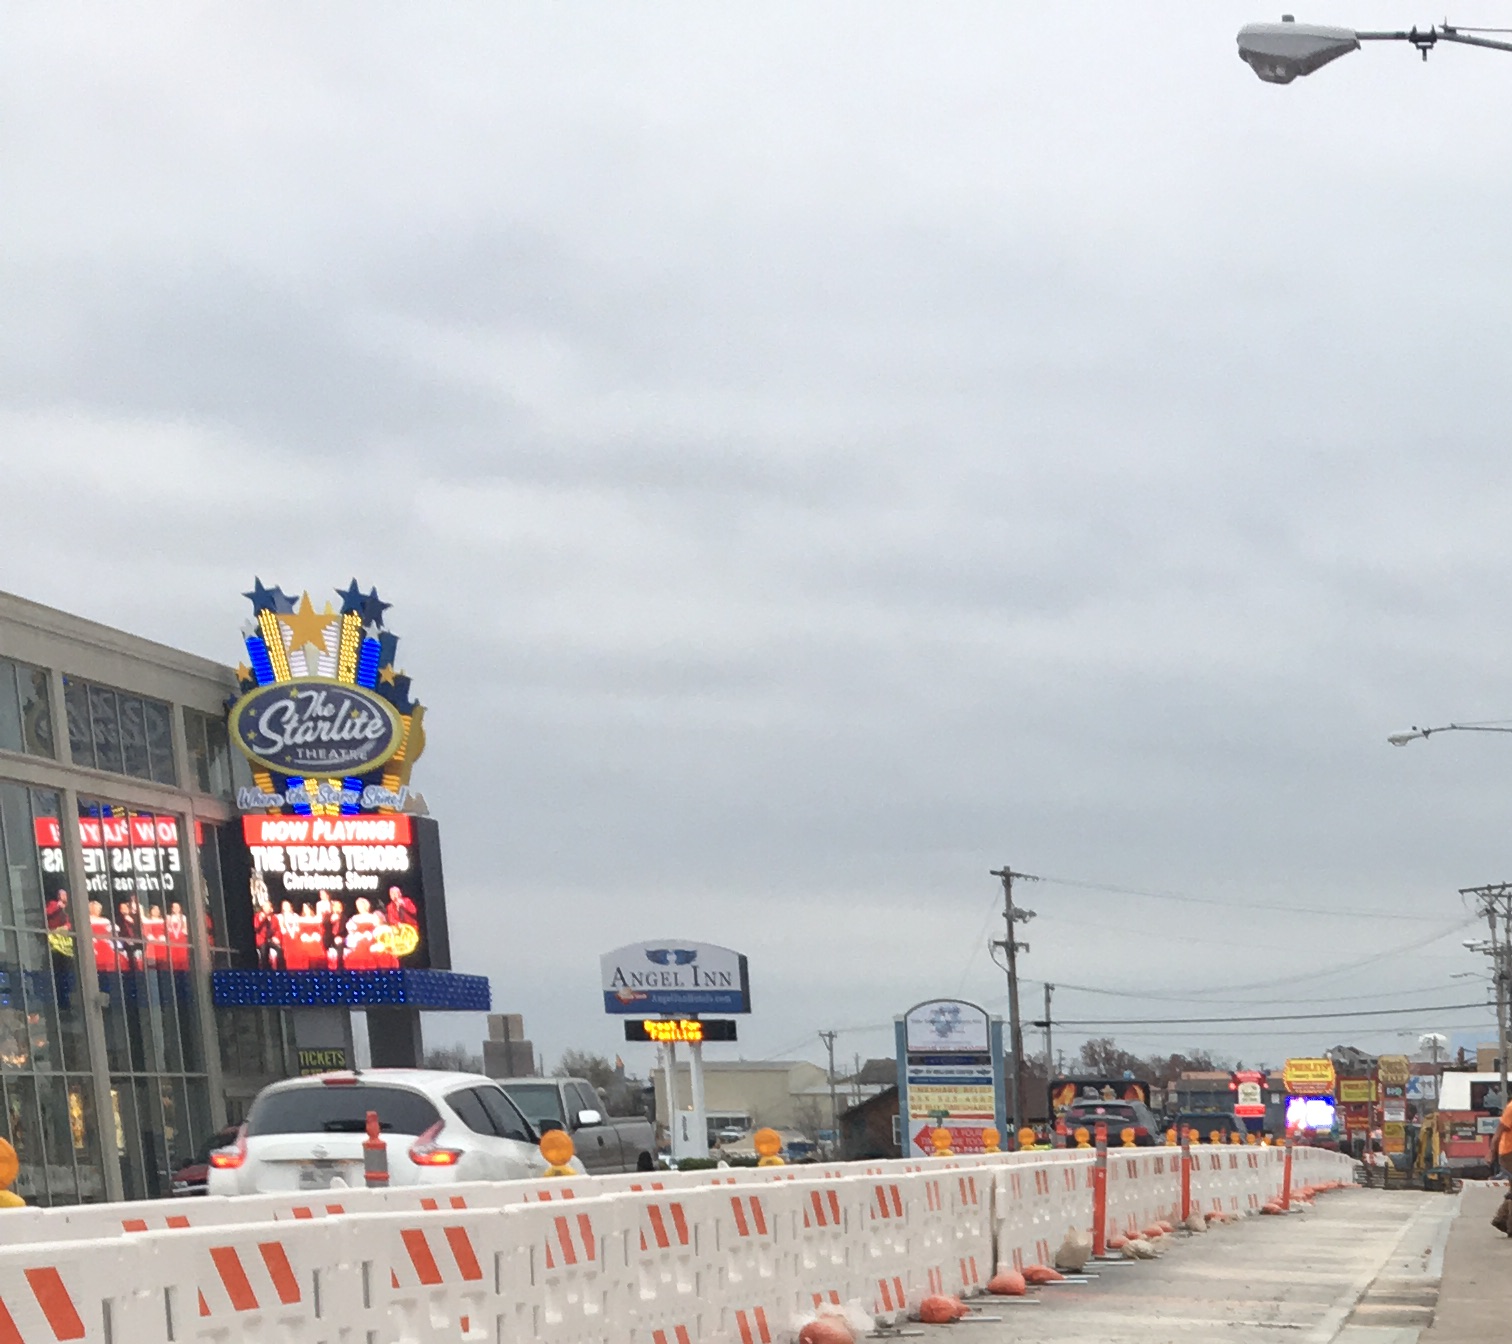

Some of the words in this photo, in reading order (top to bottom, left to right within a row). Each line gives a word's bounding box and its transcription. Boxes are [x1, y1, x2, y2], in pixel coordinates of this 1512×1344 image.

[297, 690, 335, 721] The
[252, 699, 386, 755] Starlite
[296, 748, 368, 760] THEATRE
[261, 821, 308, 841] NOW
[312, 820, 395, 841] PLAYING!
[251, 846, 285, 872] THE
[286, 846, 341, 872] TEXAS
[343, 846, 409, 872] TENORS
[282, 872, 343, 890] Christmas
[345, 872, 378, 890] Show
[610, 966, 685, 988] ANGEL
[691, 965, 732, 987] INN
[299, 1050, 345, 1067] TICKETS
